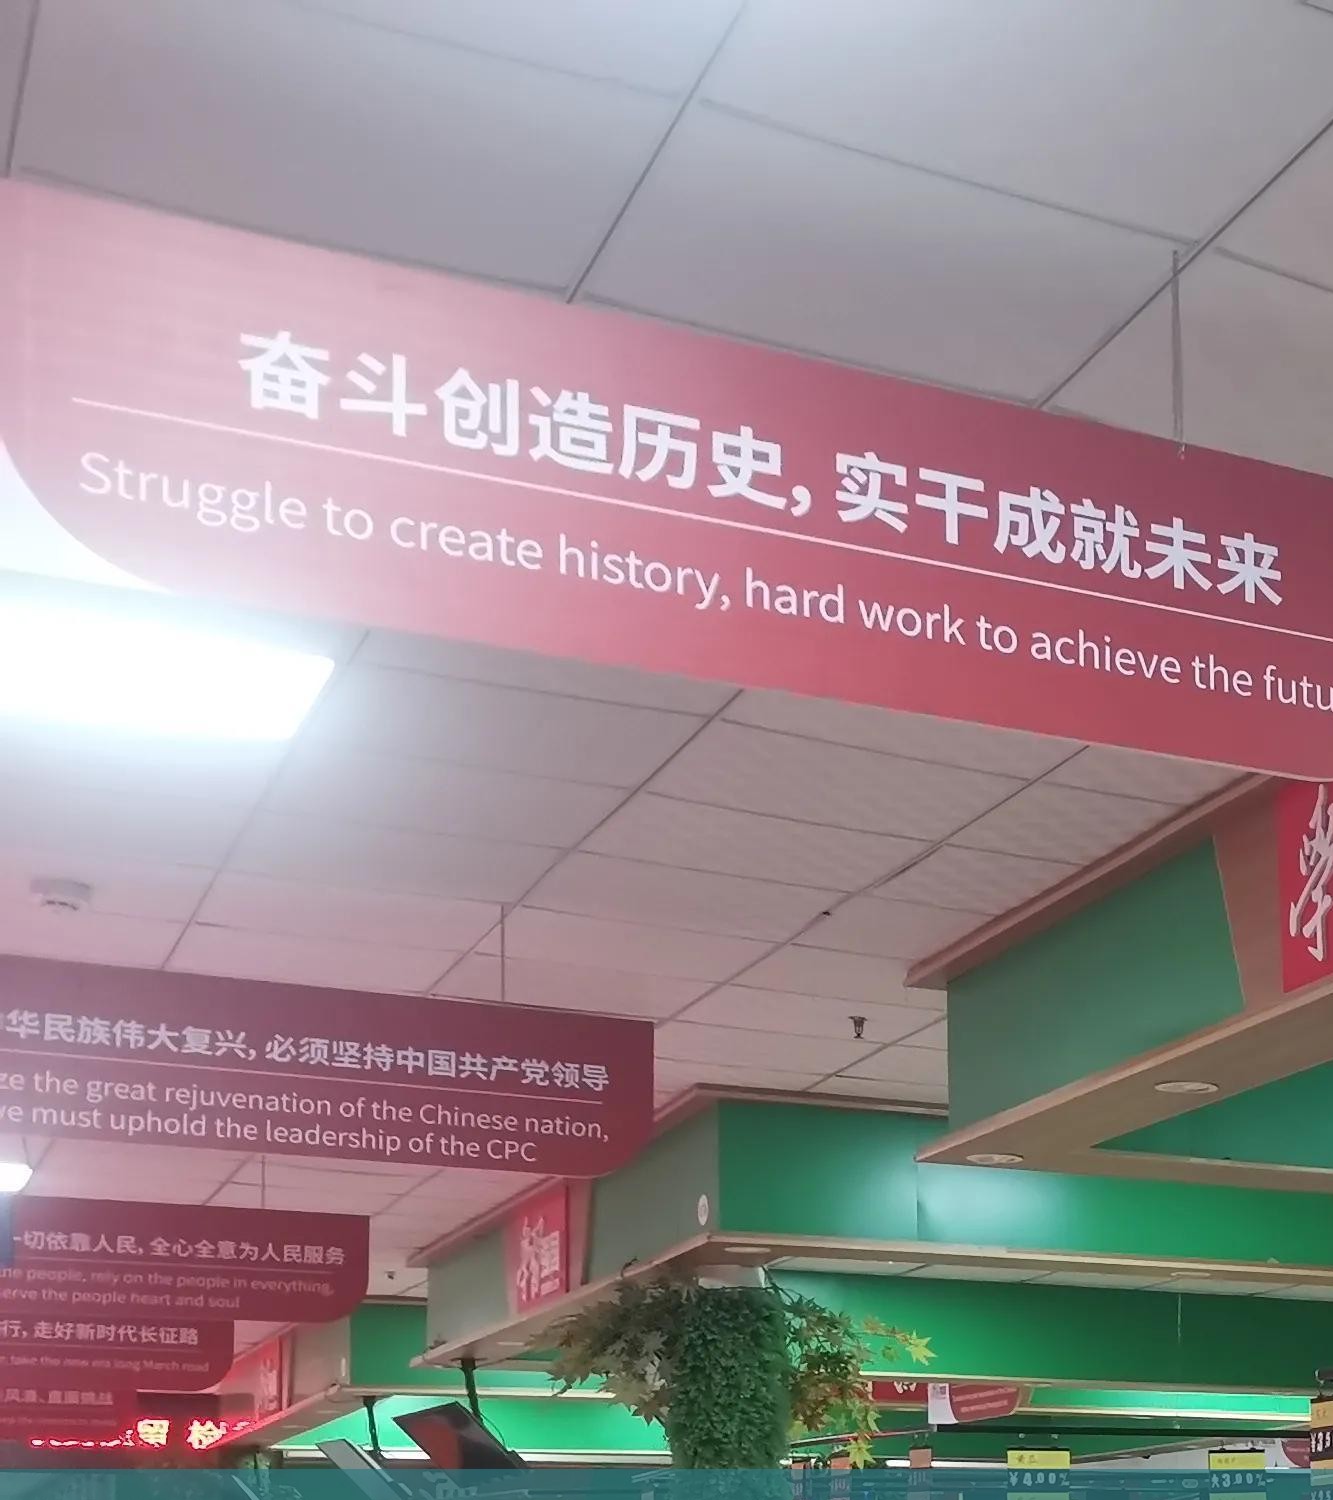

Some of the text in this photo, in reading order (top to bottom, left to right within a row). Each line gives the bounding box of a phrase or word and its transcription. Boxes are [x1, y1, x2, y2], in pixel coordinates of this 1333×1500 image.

[80, 450, 307, 531] Struggle
[322, 497, 373, 539] to
[390, 514, 543, 570] create
[559, 533, 730, 611] history,
[745, 566, 844, 624] hard
[858, 599, 966, 646] work
[976, 614, 1018, 654] to
[1031, 624, 1181, 684] achieve
[1191, 654, 1252, 696] the
[0, 1008, 610, 1091] 华民族伟大复兴，必须坚持中国共产党领导
[32, 1106, 102, 1129] must
[110, 1109, 207, 1136] uphold
[215, 1116, 258, 1141] the
[266, 1119, 401, 1156] leadership
[408, 1132, 434, 1154] of
[439, 1136, 480, 1158] the
[487, 1139, 537, 1162] CPC
[34, 1070, 79, 1095] the
[86, 1080, 157, 1103] great
[165, 1084, 332, 1115] rejuvenation
[340, 1097, 366, 1118] of
[372, 1101, 413, 1122] the
[419, 1104, 518, 1131] Chinese
[525, 1116, 609, 1143] nation,
[42, 1287, 67, 1302] the
[71, 1291, 126, 1307] people
[175, 1293, 204, 1309] and
[147, 1272, 173, 1286] the
[176, 1276, 229, 1293] people
